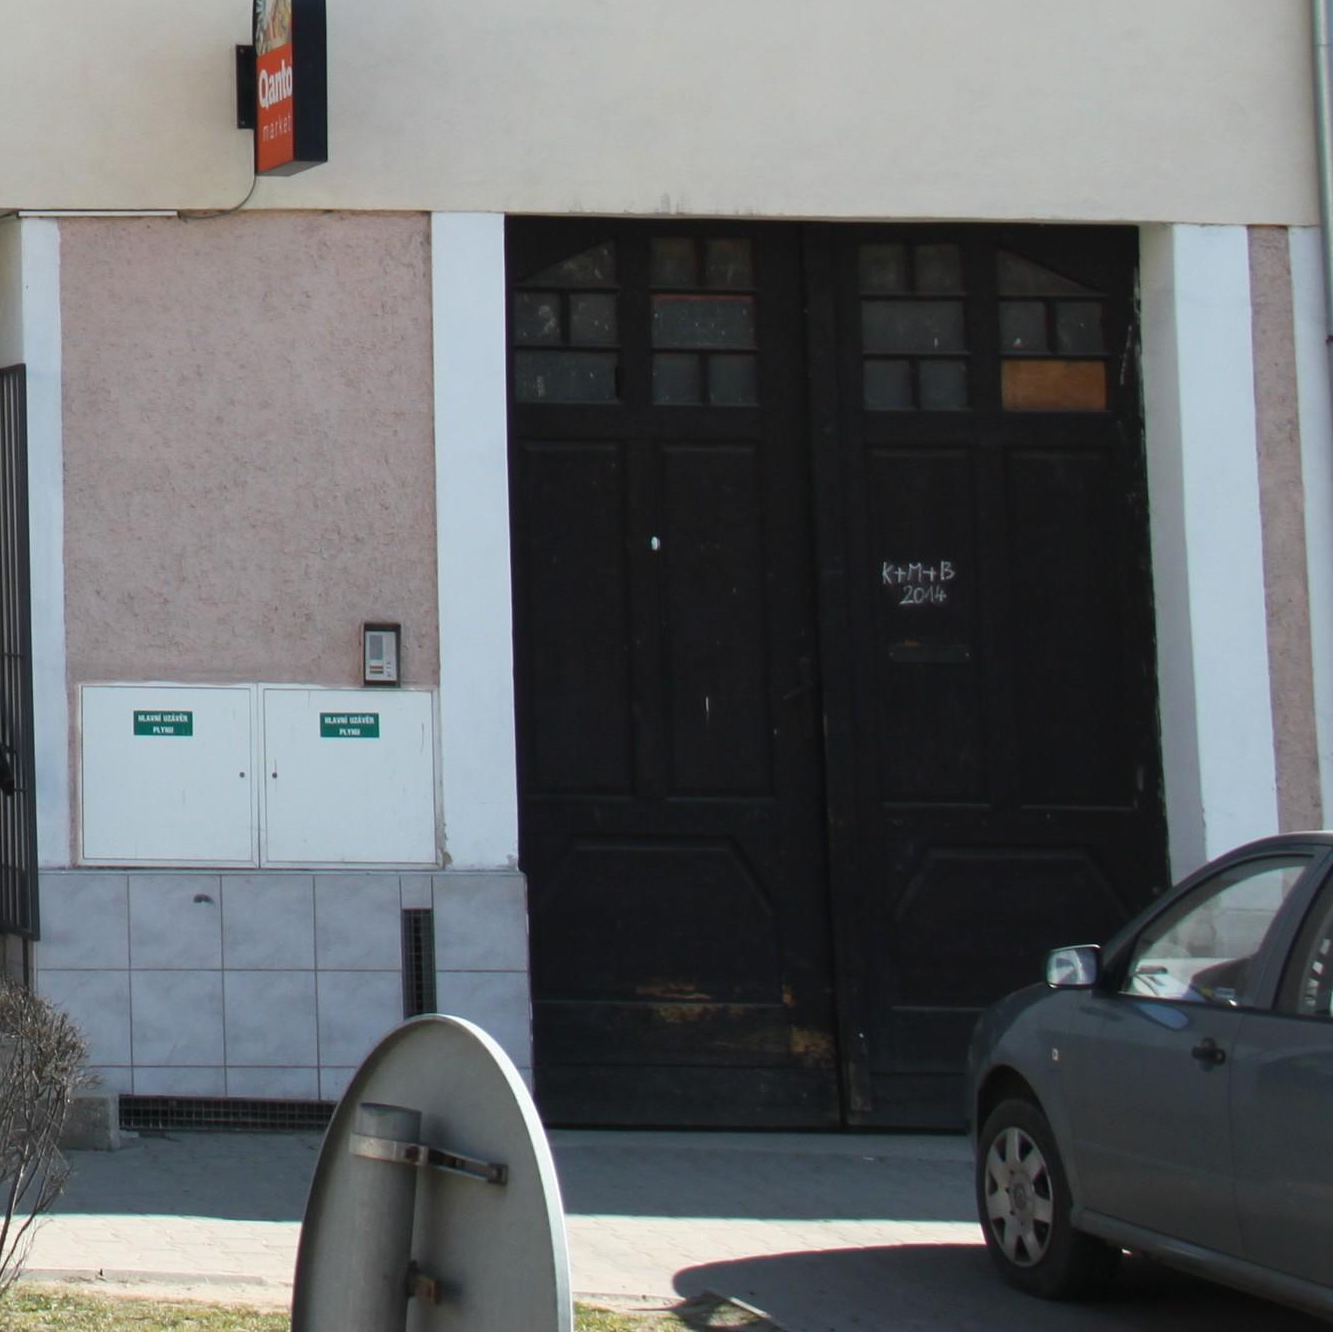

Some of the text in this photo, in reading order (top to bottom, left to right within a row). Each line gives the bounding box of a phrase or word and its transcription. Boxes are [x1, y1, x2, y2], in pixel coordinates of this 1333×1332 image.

[259, 59, 293, 110] Qanto
[262, 115, 292, 141] market
[899, 585, 947, 605] 2014
